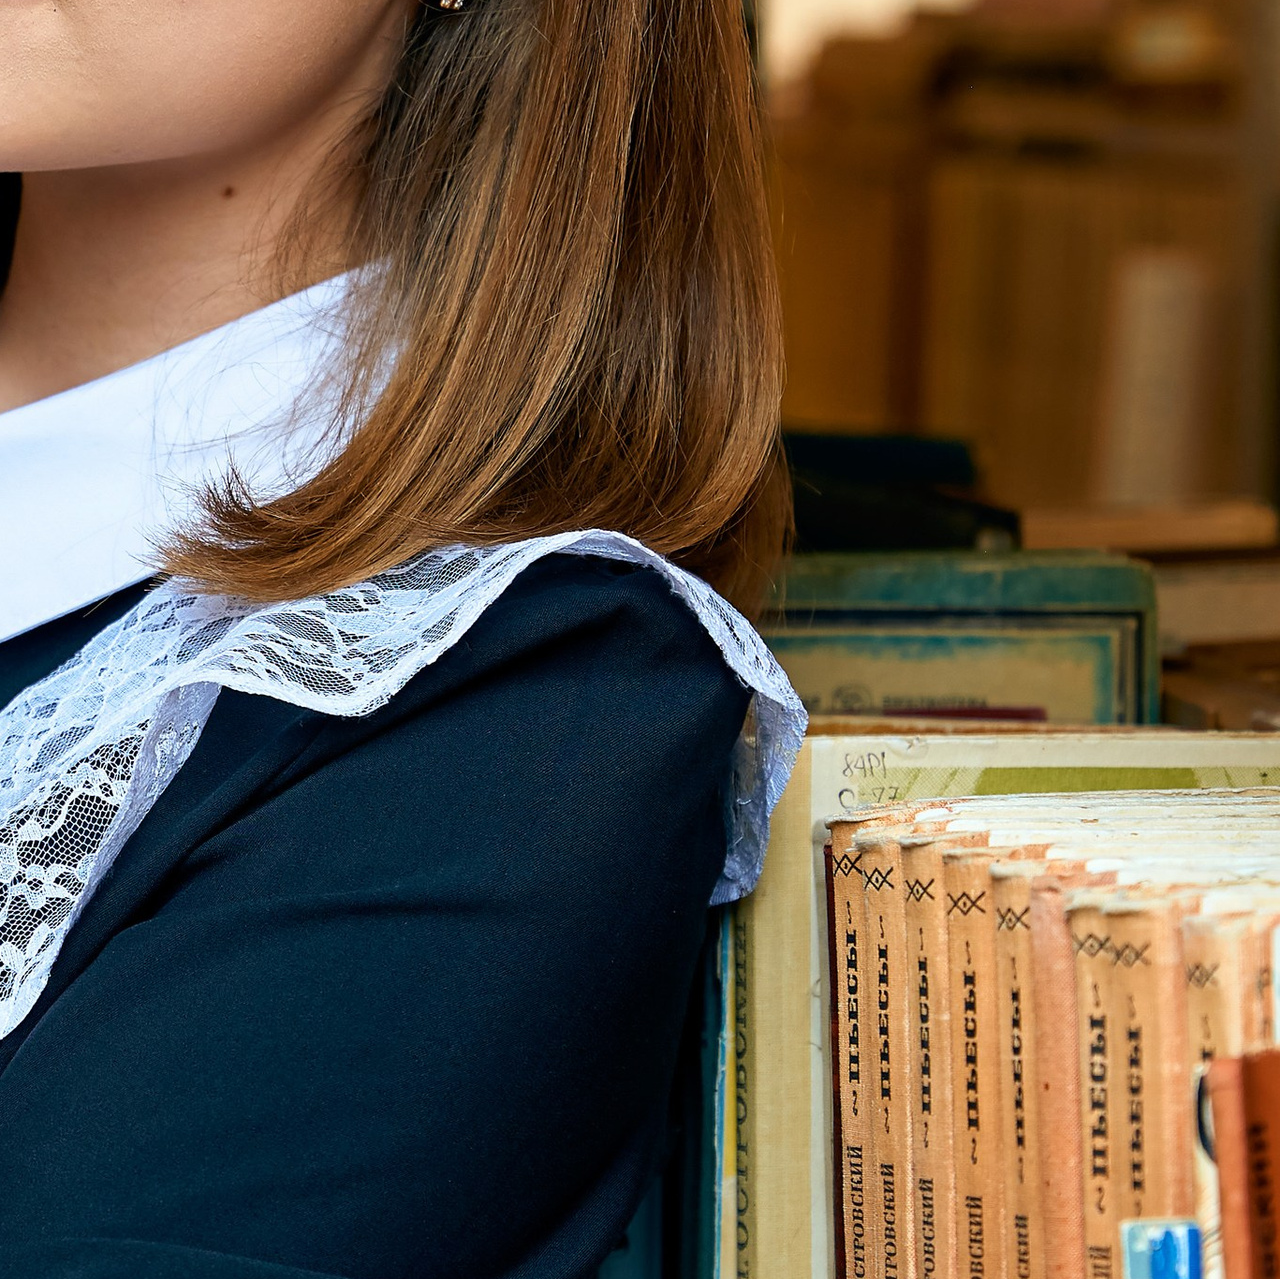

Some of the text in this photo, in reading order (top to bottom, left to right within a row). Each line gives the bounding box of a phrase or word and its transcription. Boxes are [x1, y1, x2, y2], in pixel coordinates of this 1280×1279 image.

[846, 929, 860, 1084] ПЬЕСЫ
[878, 944, 891, 1101] ПЬЕСЫ
[918, 957, 931, 1115] ПЬЕСЫ
[963, 970, 979, 1131] ПЬЕСЫ
[1089, 1015, 1108, 1178] ПЬЕСЫ
